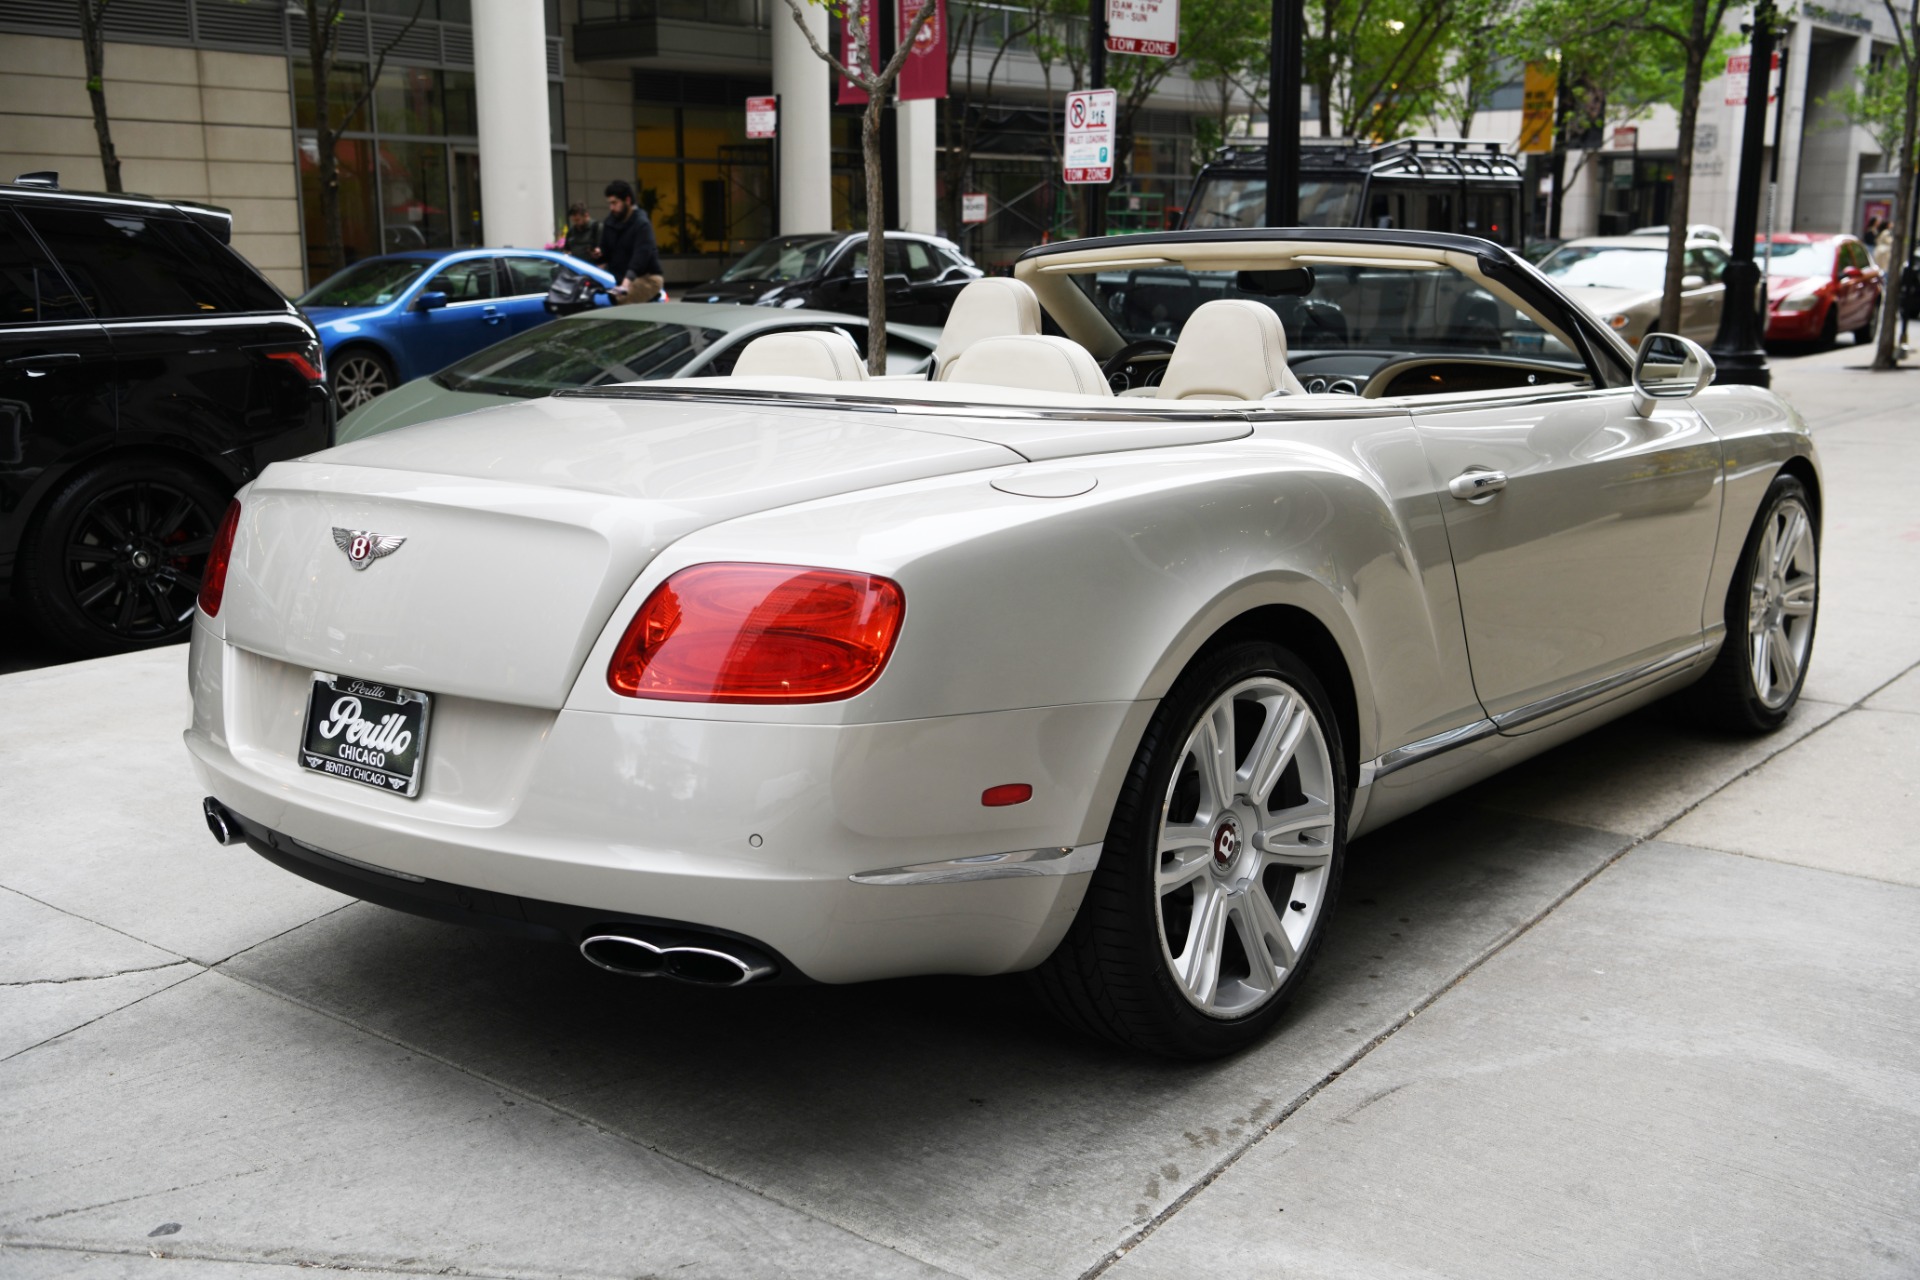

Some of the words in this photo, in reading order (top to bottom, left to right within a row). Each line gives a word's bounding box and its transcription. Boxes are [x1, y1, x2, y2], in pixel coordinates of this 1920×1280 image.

[1111, 11, 1124, 20] FRI
[1131, 12, 1148, 22] SUN
[1111, 38, 1136, 51] TOW
[1141, 41, 1171, 55] ZONE
[1067, 168, 1083, 180] TOW
[1086, 167, 1108, 180] ZONE
[348, 680, 386, 698] Perillo
[319, 696, 412, 756] Perillo
[338, 743, 386, 768] CHICAGO
[325, 760, 353, 777] BENTLEY
[353, 768, 386, 786] CHICAGO
